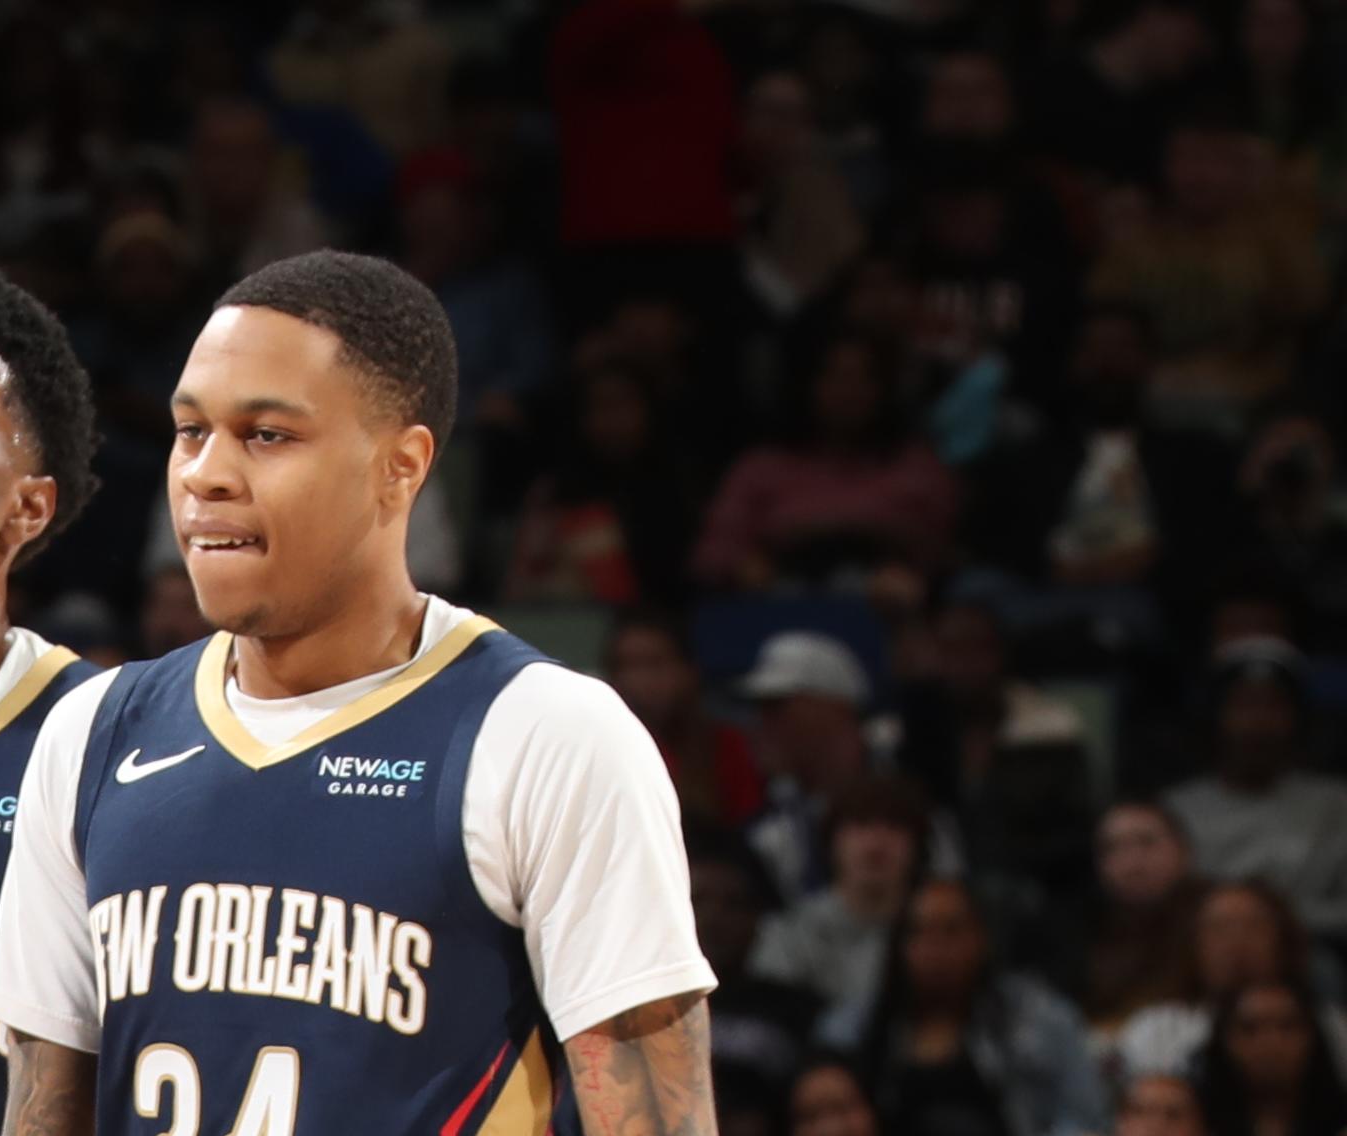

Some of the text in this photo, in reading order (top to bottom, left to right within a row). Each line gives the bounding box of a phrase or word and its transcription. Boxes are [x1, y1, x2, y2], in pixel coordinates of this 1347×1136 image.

[318, 755, 426, 781] NEWAGE
[327, 781, 407, 797] GARAGE
[172, 882, 432, 1035] ORLEANS
